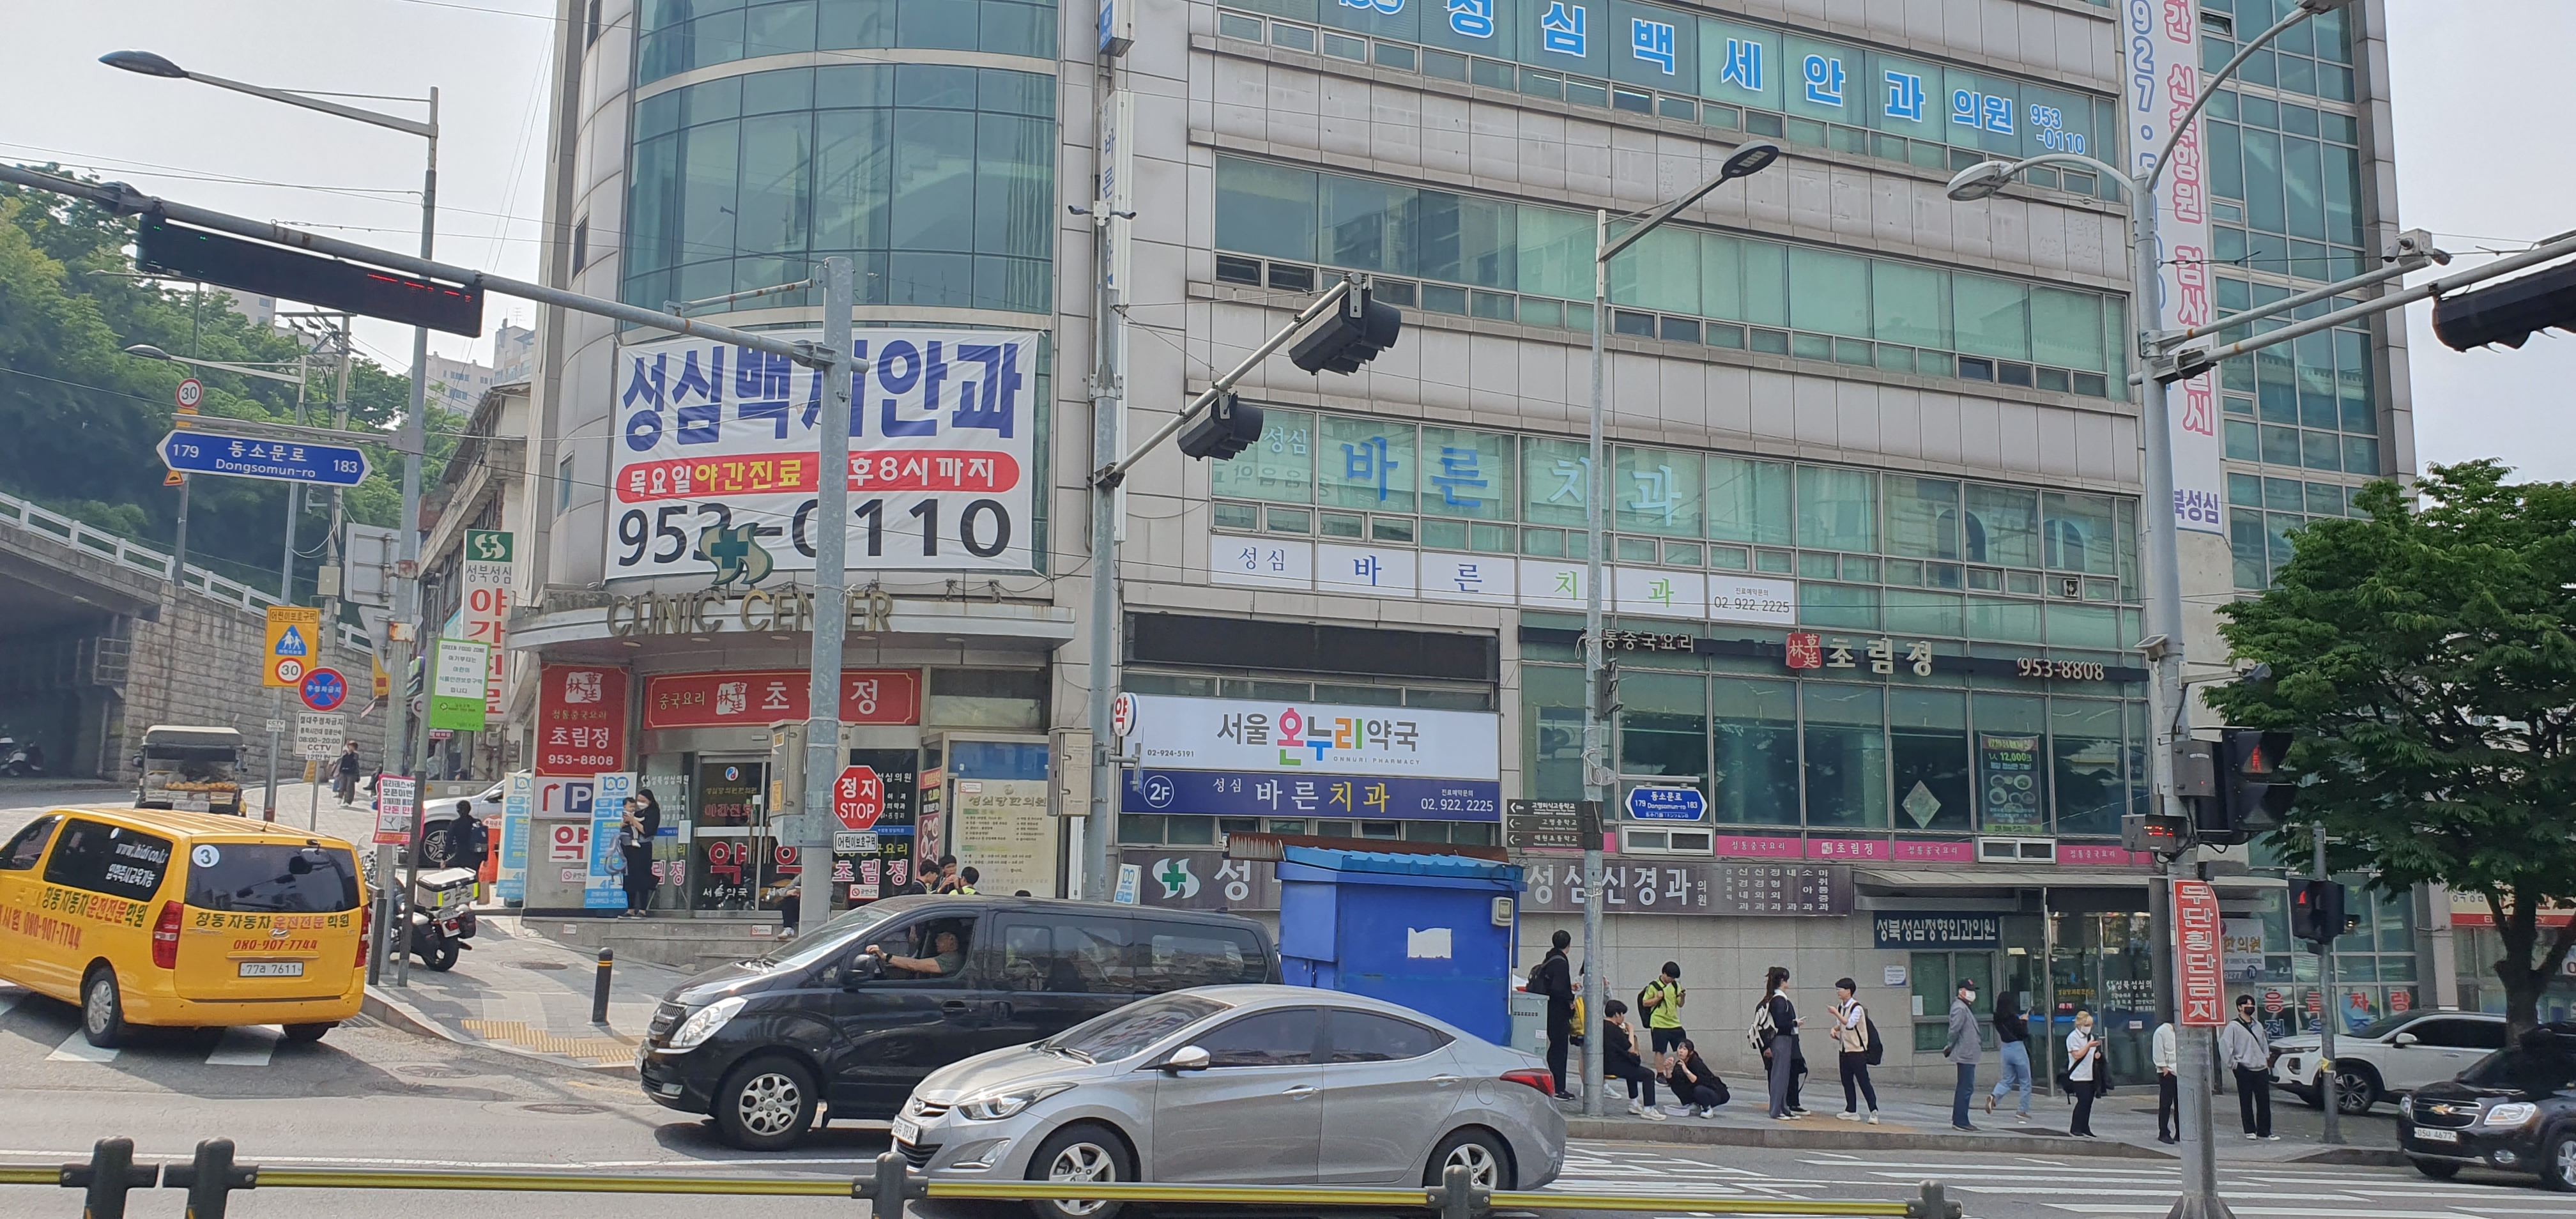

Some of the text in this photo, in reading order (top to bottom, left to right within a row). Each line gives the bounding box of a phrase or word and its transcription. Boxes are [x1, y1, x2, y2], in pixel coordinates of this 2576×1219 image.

[2163, 0, 2192, 44] 간
[2030, 104, 2062, 128] 953
[2036, 129, 2086, 155] -0110
[183, 386, 197, 400] 30
[1263, 426, 1307, 455] 성심
[172, 441, 358, 473] 179 동소문로 183
[215, 458, 316, 479] Dongsomun-ro
[1237, 546, 1286, 572] 성심
[466, 564, 512, 585] 성북성심
[1735, 587, 1768, 597] 진료예약문의
[271, 611, 316, 622] 어린이보호구역
[606, 588, 894, 636] CLINIC CENER
[1602, 629, 1694, 654] 통중국요리
[1826, 638, 1932, 677] 초림정
[2018, 657, 2105, 682] 953-8808
[281, 665, 298, 675] 30
[659, 691, 706, 710] 중국요리
[761, 678, 879, 715] 초정
[551, 709, 607, 720] 정통중국요리
[1115, 696, 1128, 730] 약
[549, 726, 610, 749] 초림정
[548, 754, 614, 766] 953-8808
[1147, 749, 1421, 765] 02-924-5191 ONNURI PHARMACY
[651, 774, 689, 786] 성북성심의원
[841, 777, 877, 801] 정지
[1149, 783, 1170, 801] 2F
[1213, 778, 1242, 793] 성심
[1441, 788, 1474, 797] 진료예약문의
[383, 788, 413, 797] 오픈이벤
[572, 786, 592, 809] P
[1650, 792, 1683, 802] 동소문로
[839, 802, 875, 820] STOP
[1647, 802, 1687, 811] Dongsomun-ro
[1542, 818, 1577, 827] 고명중학교
[837, 835, 877, 848] 어린이보호구역
[1731, 841, 2116, 859] 정통중국요리 초림정 정통중국요리 정통중국요리
[201, 849, 211, 864] 3
[709, 841, 747, 885] 약
[831, 858, 908, 886] 초림정
[23, 911, 83, 951] 080-907-7744
[233, 939, 318, 950] 080-907-7744
[2179, 885, 2218, 1021] 무단횡단금지
[272, 964, 296, 974] 7611
[2224, 971, 2242, 979] 8277
[2115, 979, 2153, 990] 성북성심의
[2263, 991, 2411, 1014] 응급차량
